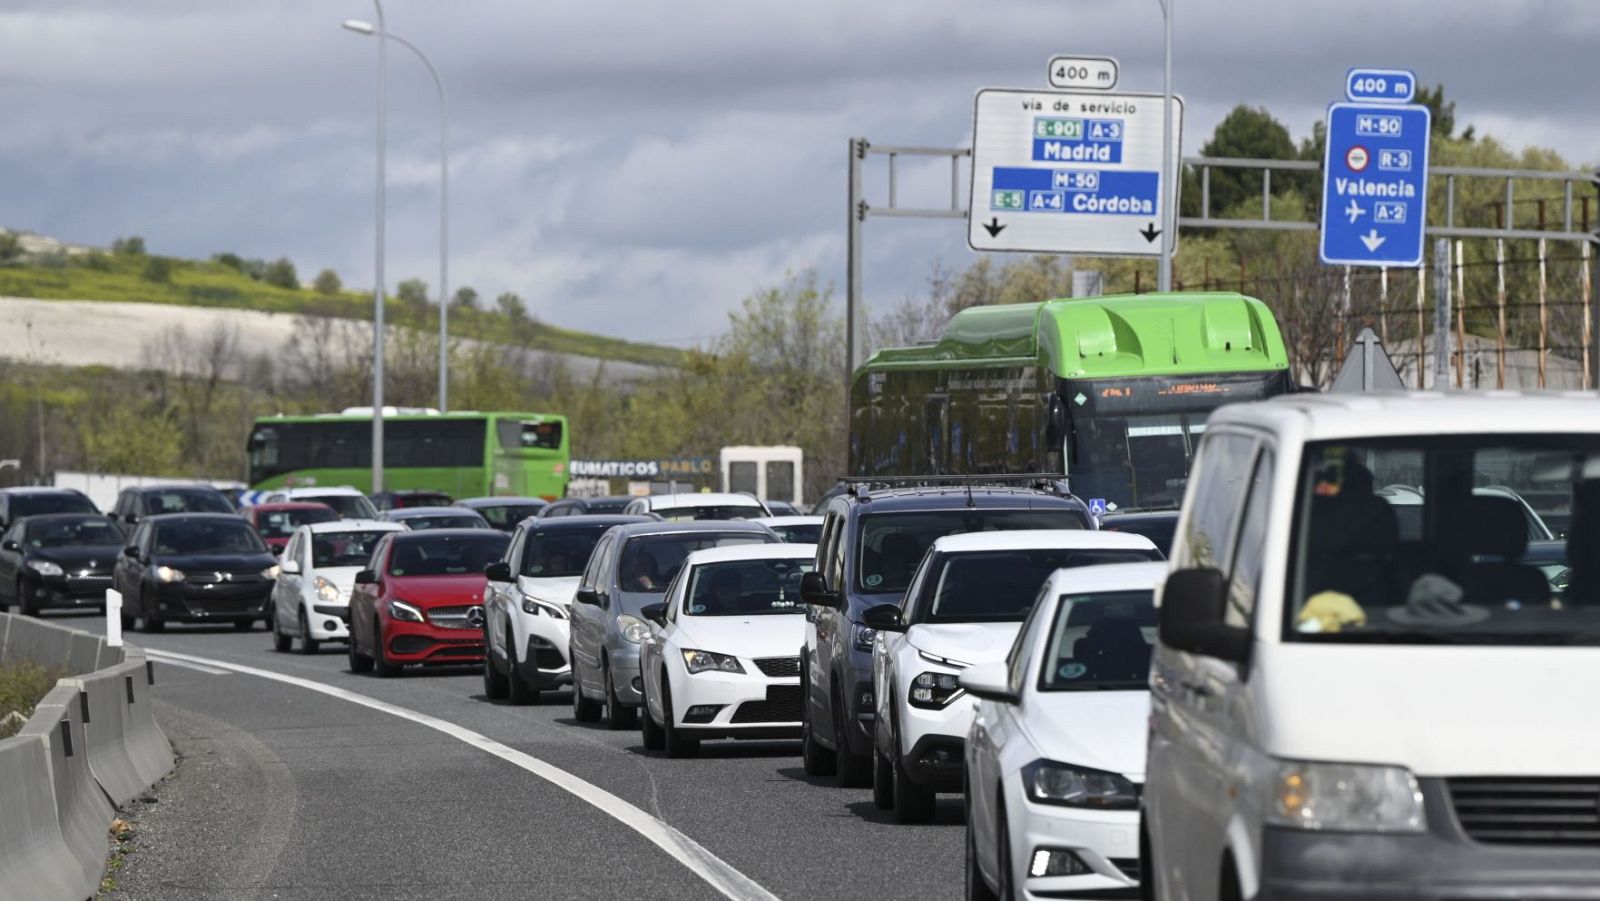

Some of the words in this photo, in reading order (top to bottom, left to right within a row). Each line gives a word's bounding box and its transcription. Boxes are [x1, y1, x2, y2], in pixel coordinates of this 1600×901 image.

[1055, 66, 1088, 80] 400
[1097, 70, 1110, 80] m
[1353, 78, 1386, 93] 400
[1394, 83, 1407, 94] m
[1053, 100, 1069, 111] de
[1080, 101, 1136, 114] servicio
[1044, 142, 1110, 160] Madrid
[1335, 177, 1415, 197] Valencia
[1073, 193, 1152, 213] Córdoba
[661, 459, 712, 473] PABLO
